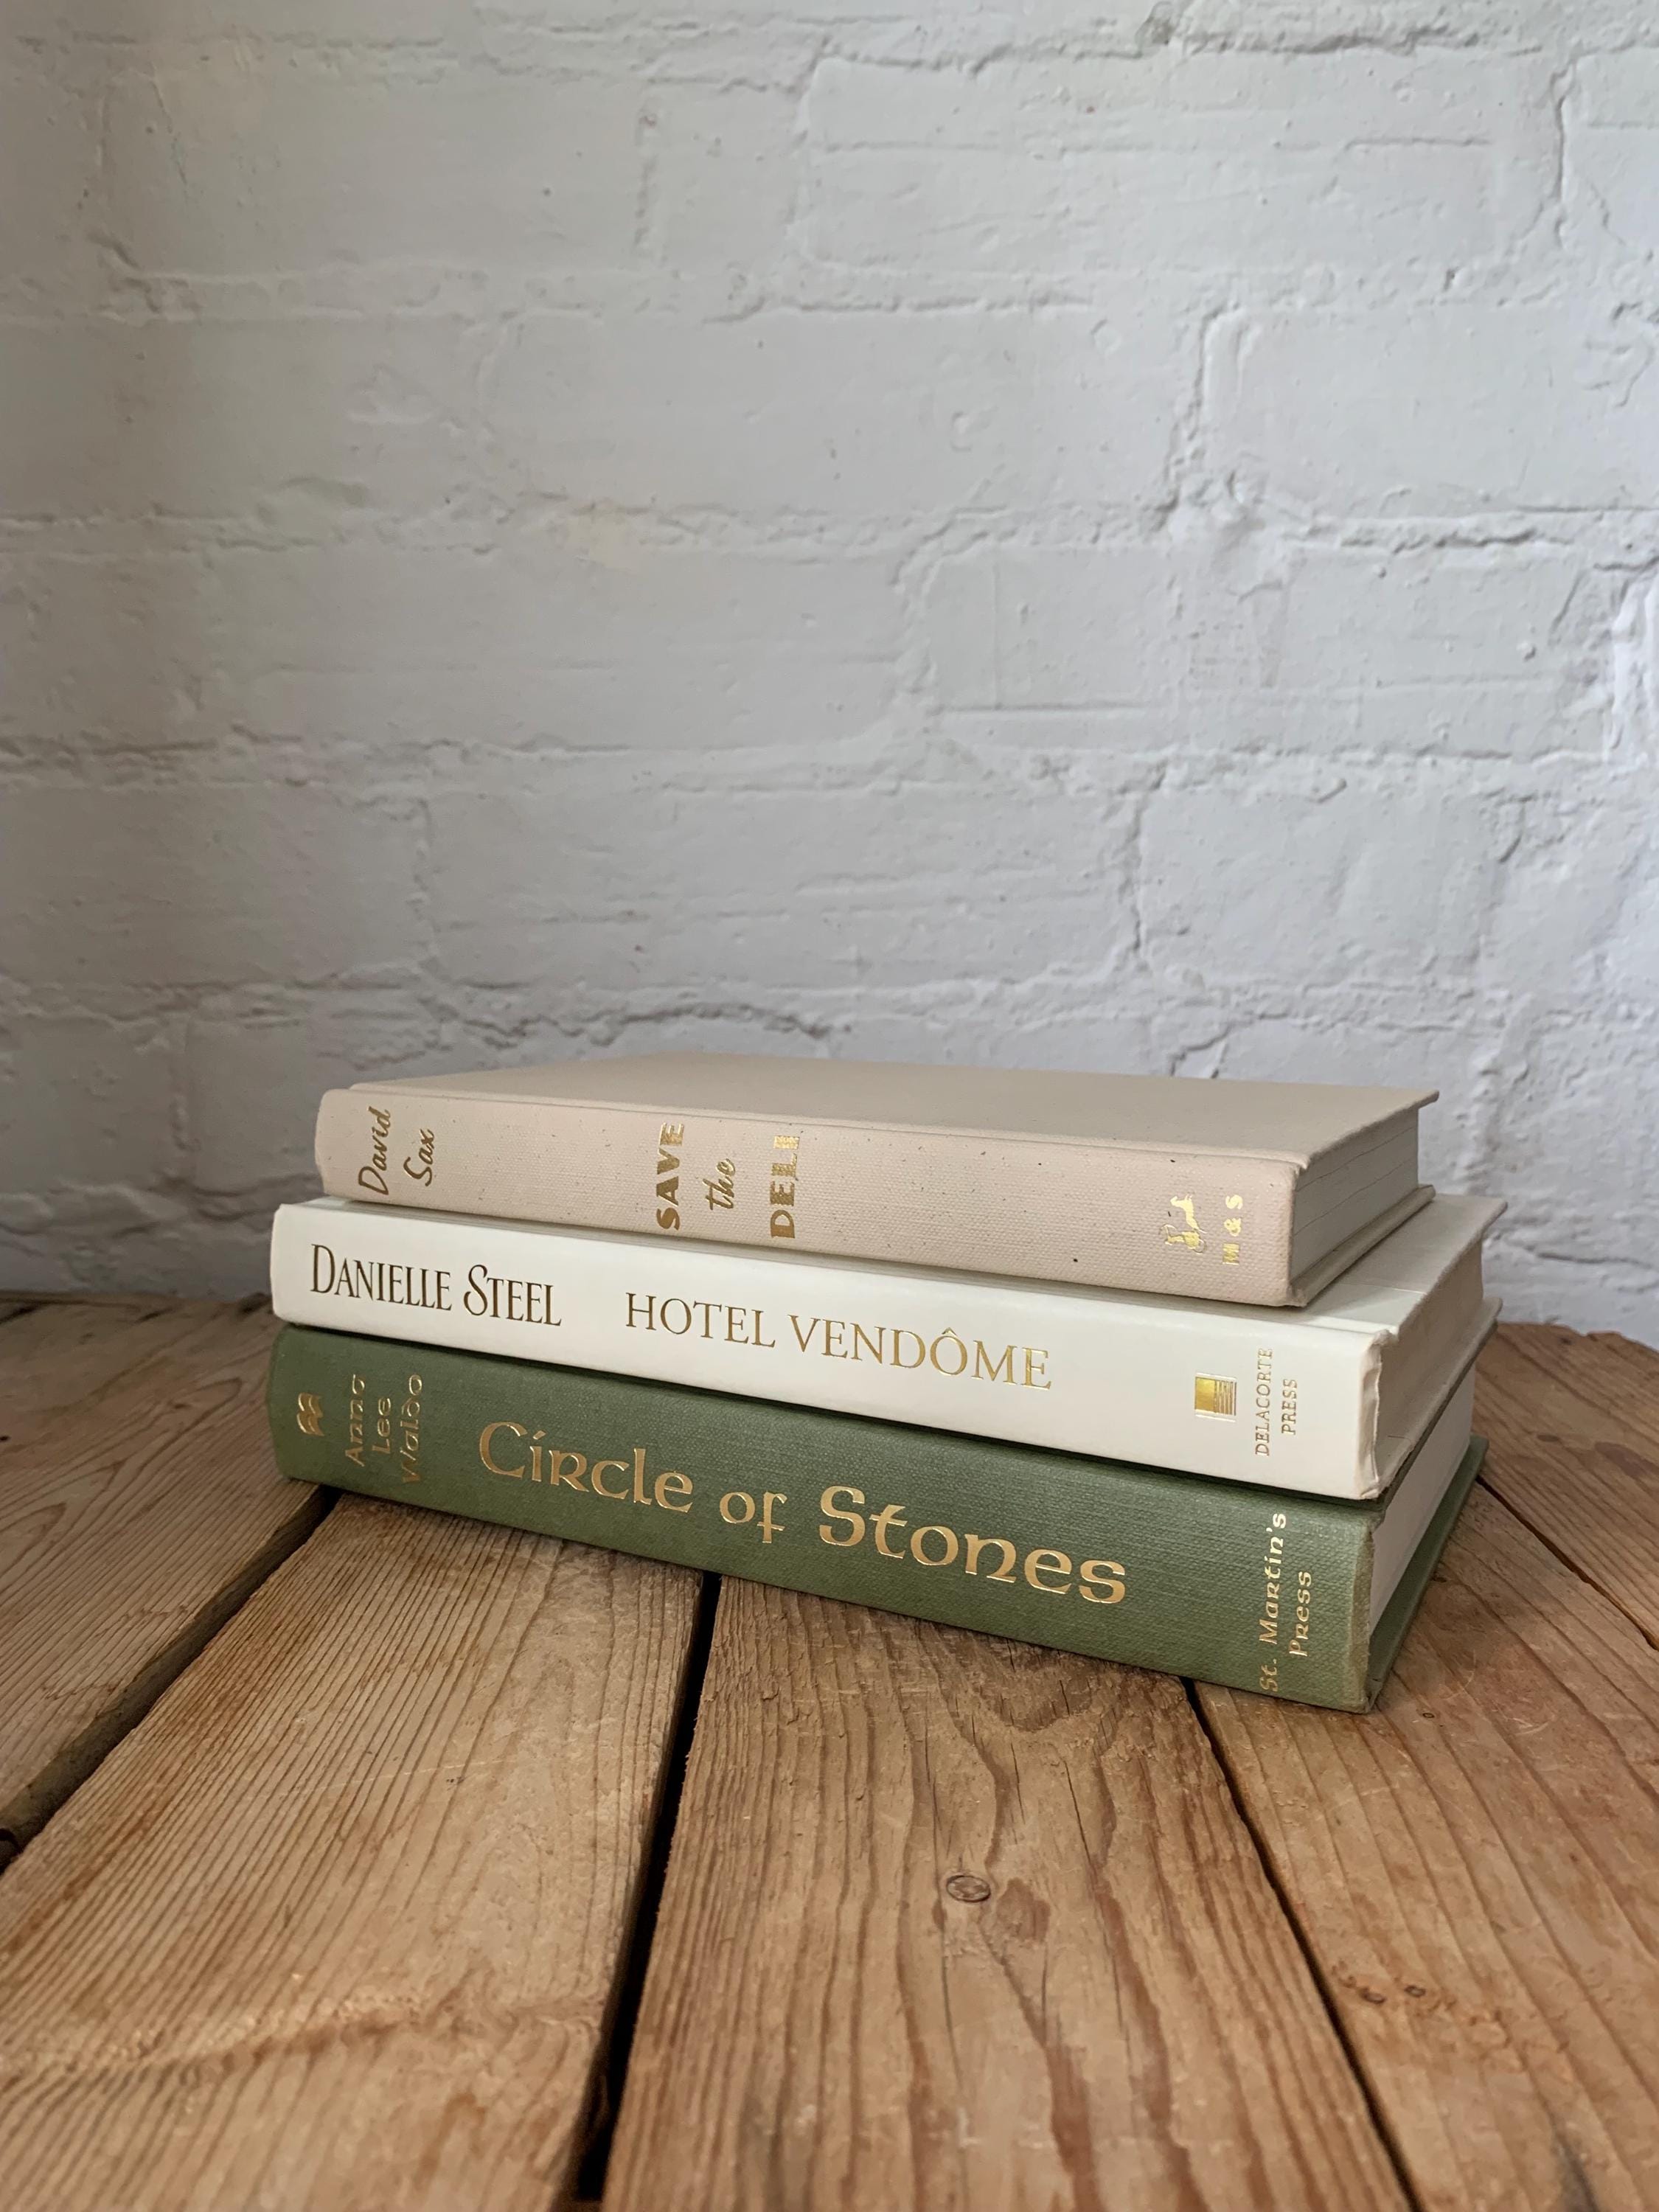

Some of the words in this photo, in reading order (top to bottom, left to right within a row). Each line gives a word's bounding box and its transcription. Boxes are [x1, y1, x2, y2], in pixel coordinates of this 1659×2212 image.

[358, 1106, 391, 1195] David
[403, 1128, 434, 1186] Sax
[656, 1122, 684, 1231] SAVE
[703, 1158, 736, 1210] the
[770, 1135, 800, 1239] DELI
[1224, 1217, 1242, 1237] &
[1225, 1194, 1244, 1209] S
[310, 1244, 453, 1311] DANIELLE
[463, 1265, 562, 1326] STEEL
[1222, 1242, 1240, 1265] M
[625, 1292, 776, 1349] HOTEL
[787, 1315, 1052, 1391] VENDÔME
[345, 1374, 365, 1467] Anna
[372, 1397, 391, 1454] Lee
[400, 1374, 422, 1483] Waldo
[1255, 1347, 1273, 1456] DELACORTE
[1281, 1378, 1298, 1436] PRESS
[479, 1421, 693, 1514] Circle
[719, 1490, 787, 1544] of
[819, 1486, 1126, 1604] Stones
[1259, 1512, 1287, 1645] Martin's
[1289, 1571, 1312, 1657] Press
[1259, 1658, 1279, 1692] St.
